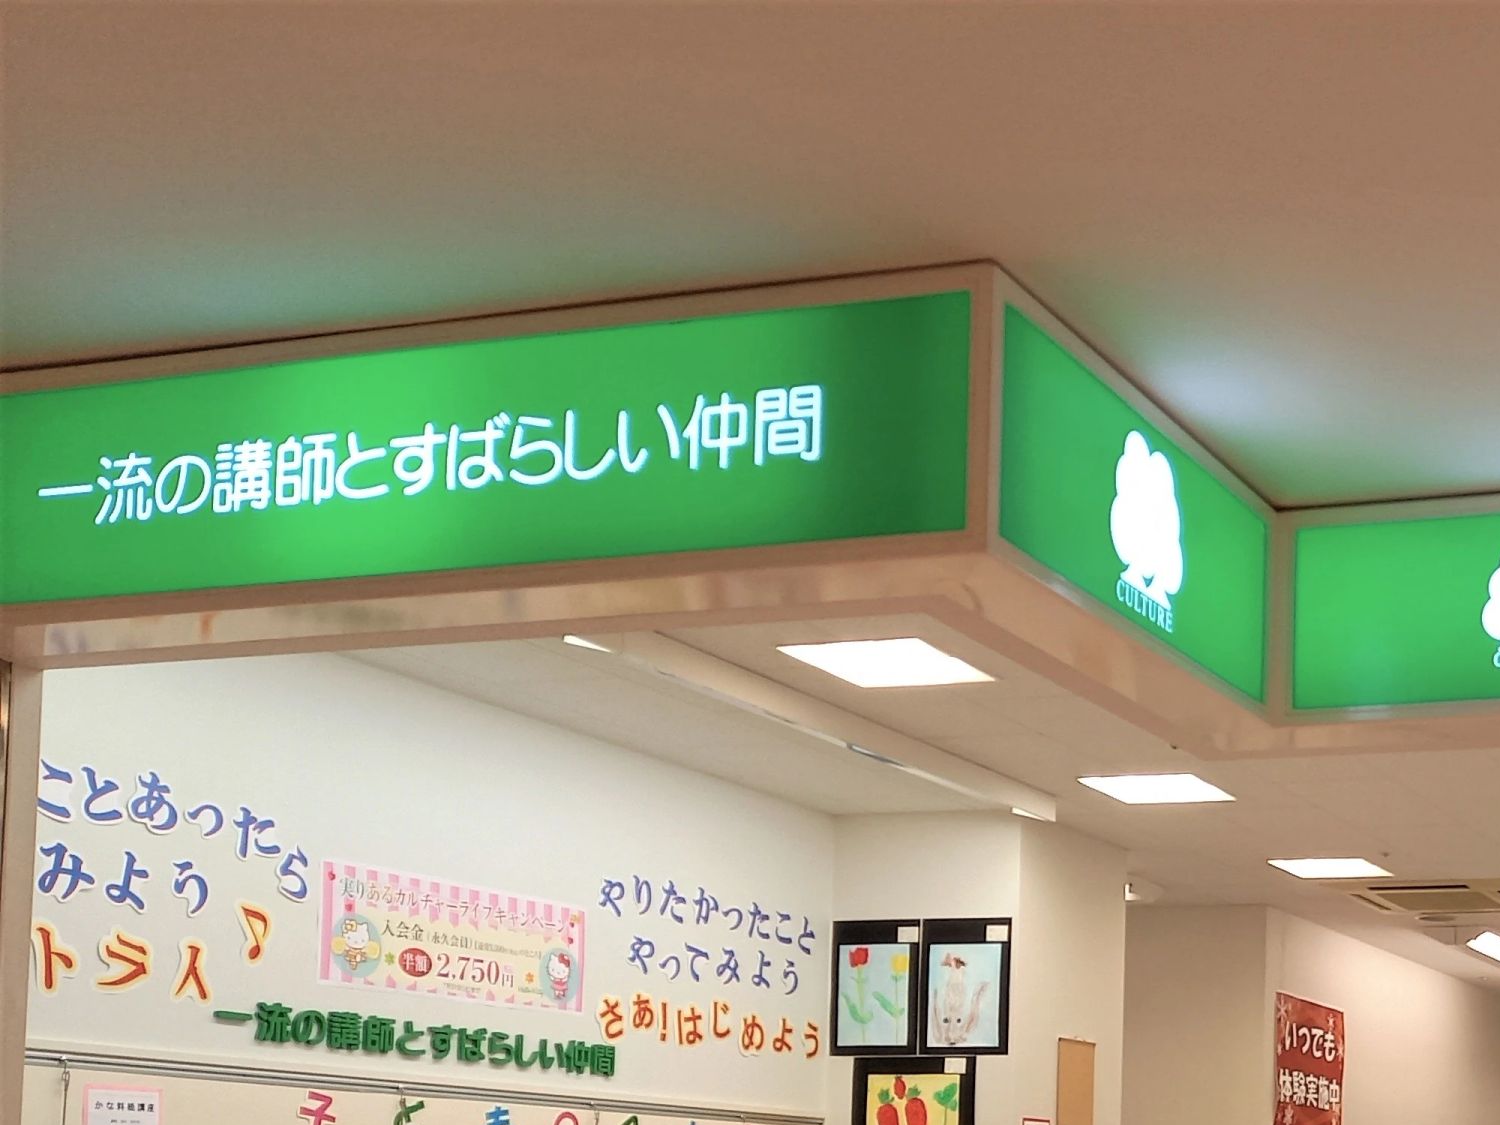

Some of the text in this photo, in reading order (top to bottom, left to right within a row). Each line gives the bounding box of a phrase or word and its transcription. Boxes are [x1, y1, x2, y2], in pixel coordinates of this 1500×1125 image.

[37, 383, 823, 524] 一流の講師とすばらしい仲間
[1116, 579, 1173, 633] CULTURE
[38, 843, 208, 914] みよう
[340, 877, 569, 933] 実りあるカルチャーライフキャンペーン
[381, 920, 424, 942] 入会金
[598, 874, 816, 955] やりたかったこと
[36, 927, 207, 1000] トライ
[401, 952, 514, 988] 半額 2,750円
[628, 935, 799, 995] やってみよう
[212, 1002, 616, 1078] 一流の講師とすばらしい仲間
[1283, 1020, 1336, 1062] いつでも
[1278, 1068, 1340, 1111] 体験実施中
